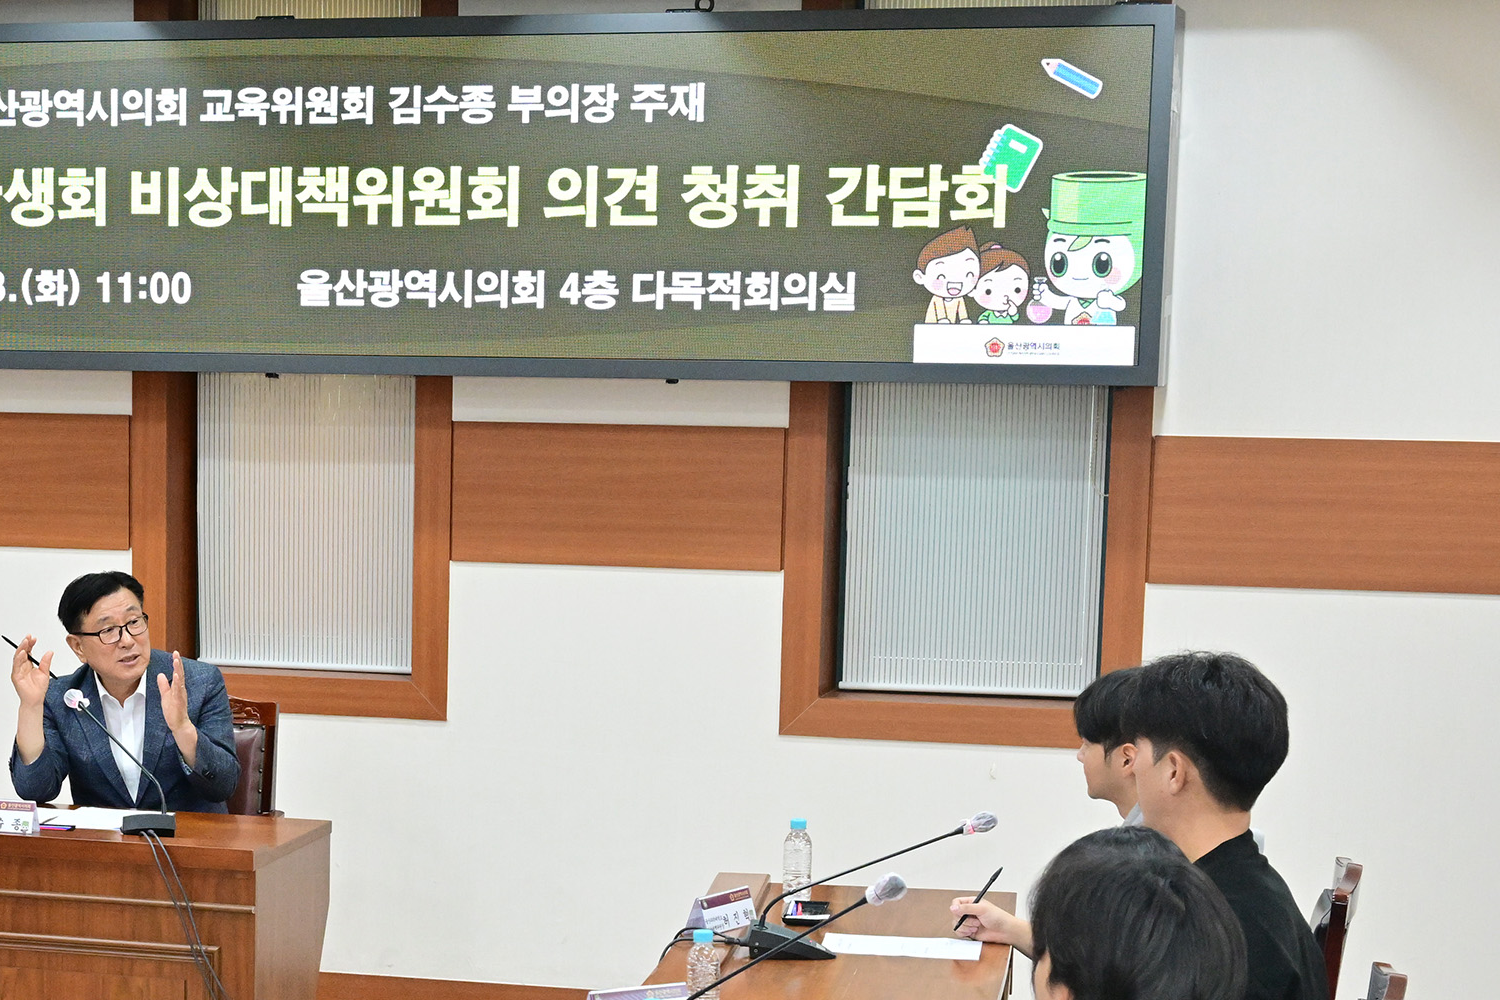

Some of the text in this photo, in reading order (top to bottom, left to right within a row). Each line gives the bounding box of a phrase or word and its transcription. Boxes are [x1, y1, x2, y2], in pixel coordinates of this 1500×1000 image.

[200, 86, 374, 126] 교육위원회
[389, 85, 496, 124] 김수종
[508, 83, 619, 123] 부의장
[630, 82, 706, 122] 주재
[131, 166, 520, 228] 비상대책위원회
[544, 165, 659, 228] 의견
[681, 165, 800, 228] 청취
[826, 164, 1009, 228] 간담회
[96, 272, 192, 304] 11:00
[297, 269, 545, 309] 울산광역시의회
[560, 270, 620, 310] 4층
[632, 271, 856, 312] 다목적회의실
